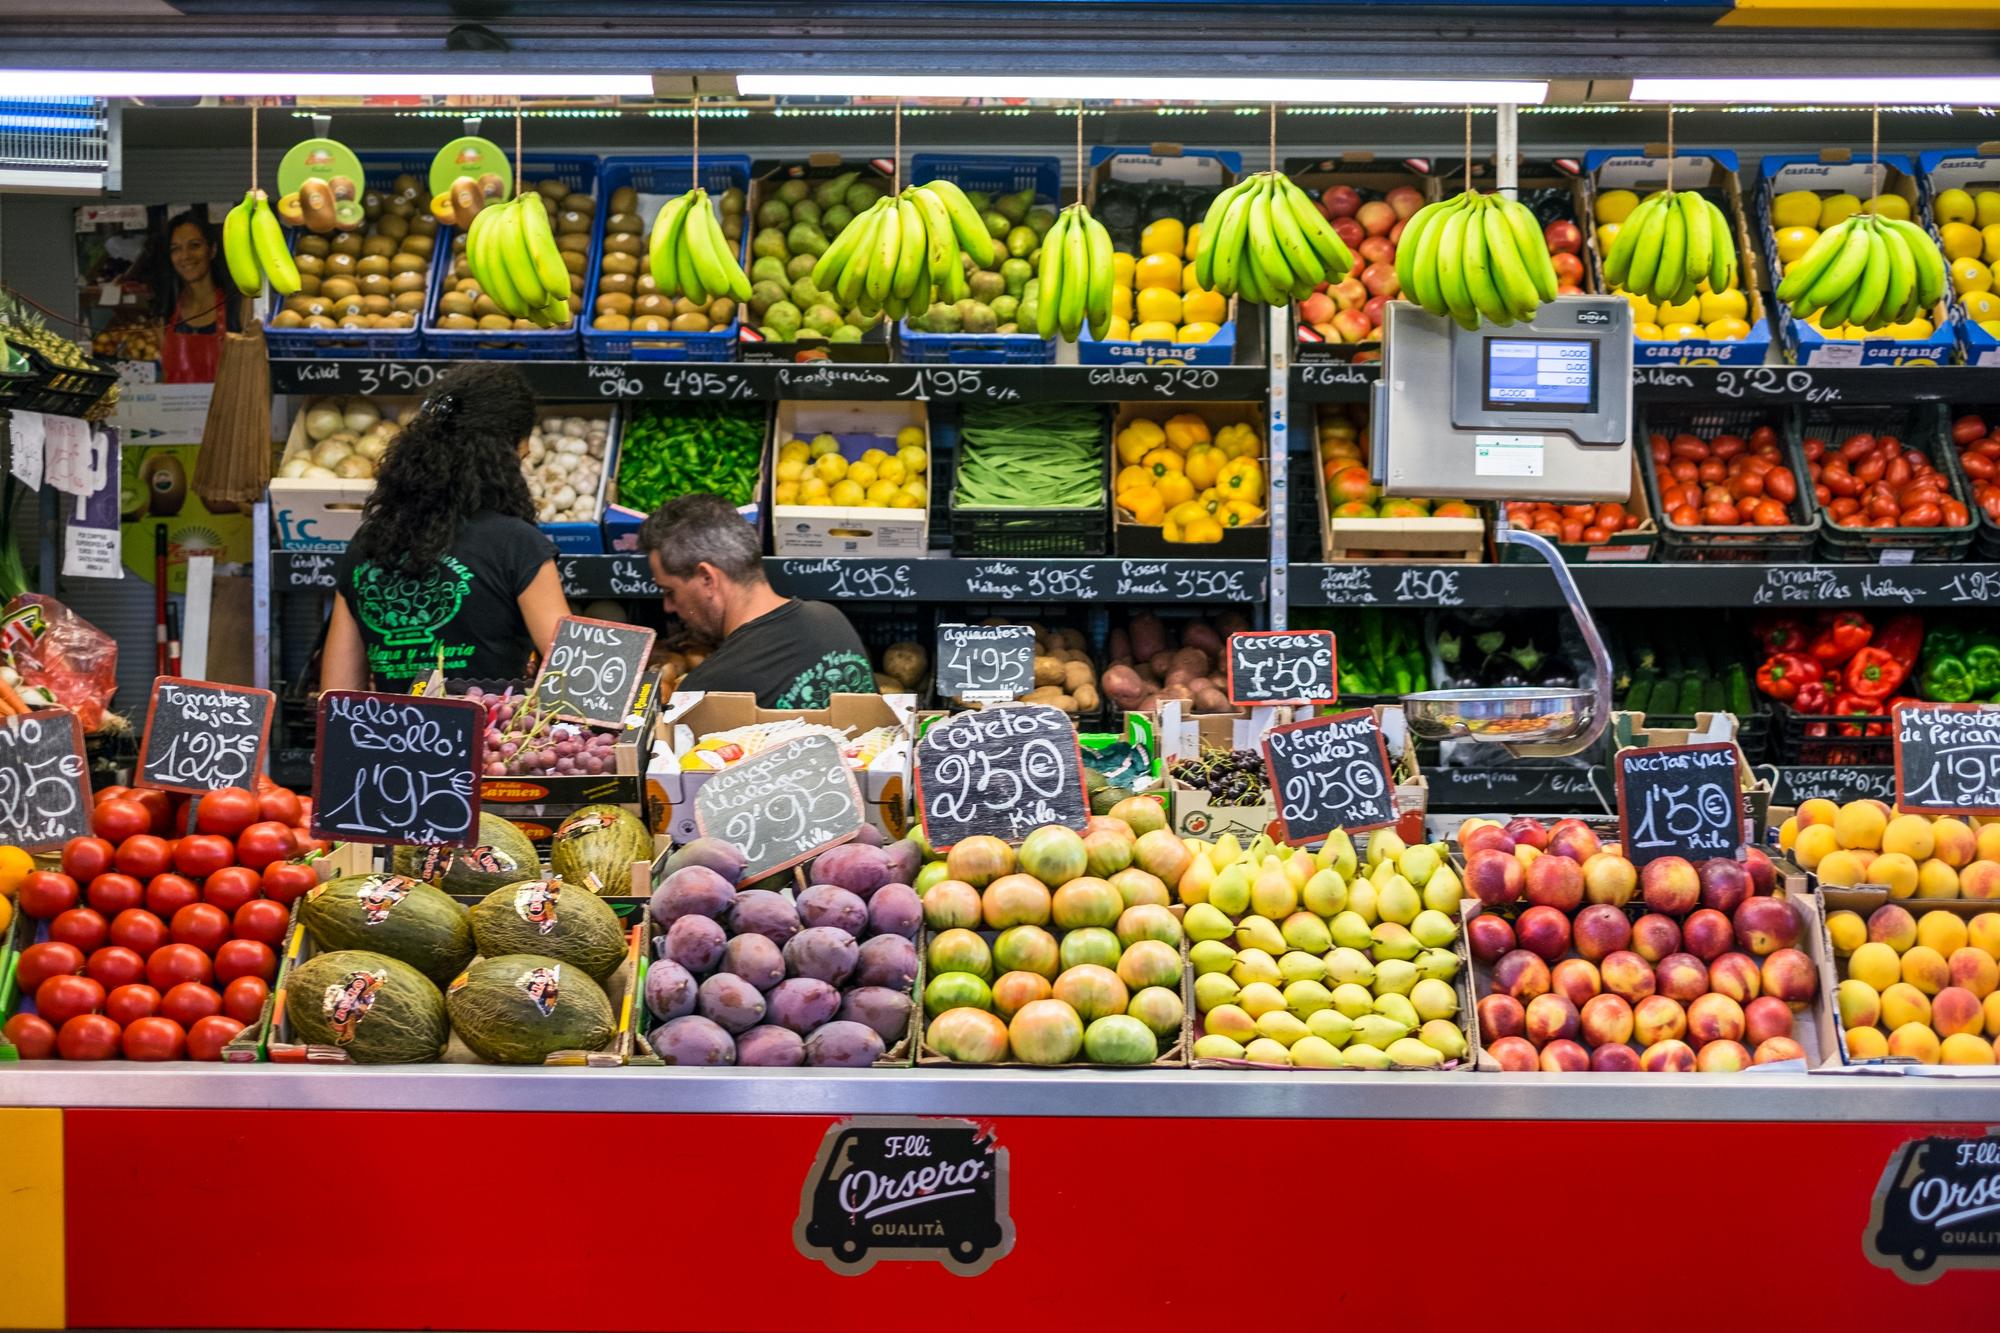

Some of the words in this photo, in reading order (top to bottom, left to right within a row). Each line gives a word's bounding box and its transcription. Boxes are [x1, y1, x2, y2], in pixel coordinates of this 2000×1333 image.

[1784, 166, 1831, 177] castang
[1940, 159, 1988, 170] castang
[1578, 313, 1609, 322] DINA
[1109, 344, 1198, 360] castang
[1645, 343, 1736, 360] castang
[1868, 344, 1943, 359] castang
[1088, 367, 1149, 385] Golden
[1632, 368, 1694, 388] olden
[276, 509, 322, 541] fc
[610, 577, 665, 594] Padró
[159, 685, 251, 709] Tomates
[182, 702, 253, 728] Rojos
[329, 696, 425, 727] Melón
[927, 708, 1062, 751] Catetos
[1899, 727, 1923, 744] de
[872, 1220, 945, 1236] QUALITÀ
